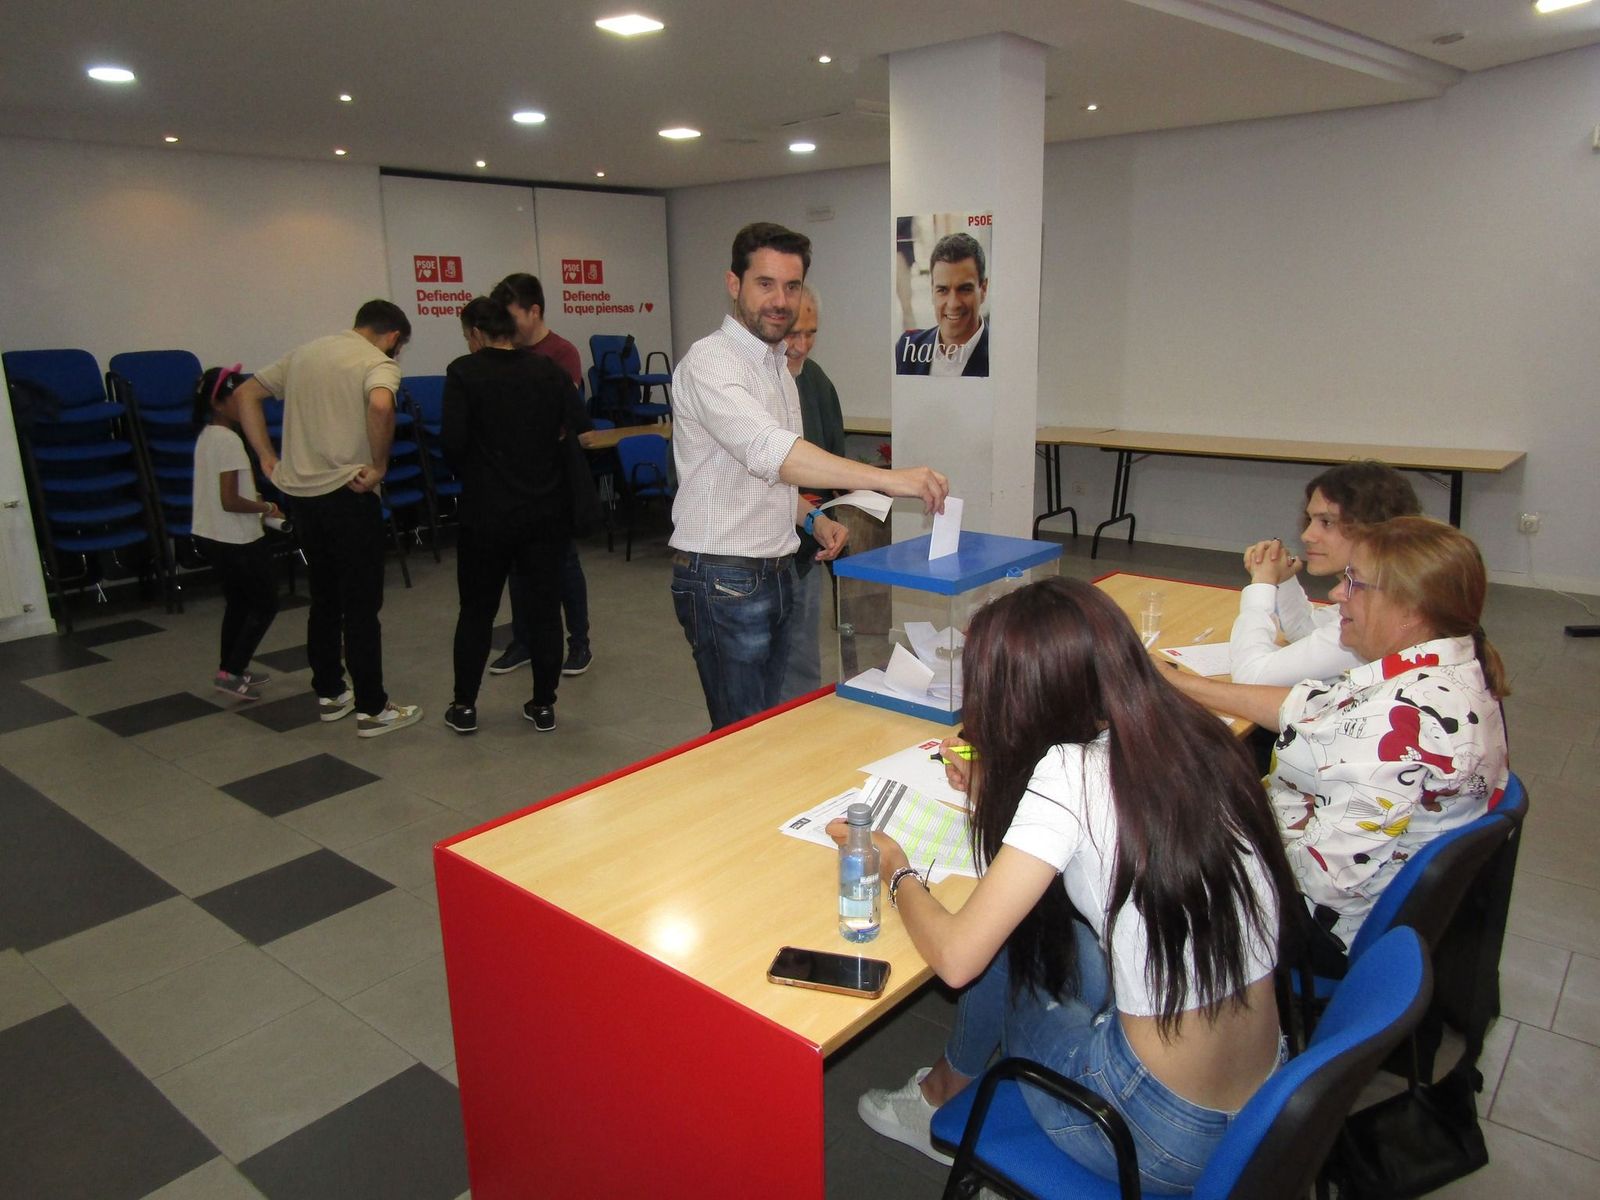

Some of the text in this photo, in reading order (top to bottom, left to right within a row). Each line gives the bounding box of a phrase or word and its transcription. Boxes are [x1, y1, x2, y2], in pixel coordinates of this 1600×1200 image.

[967, 214, 993, 227] PSOE
[416, 260, 437, 270] PSOE
[563, 263, 581, 273] PSOE
[416, 289, 473, 302] Defiende
[562, 290, 611, 302] Defiende
[417, 303, 429, 316] lo
[430, 305, 454, 318] que
[563, 302, 635, 316] lo que piensas
[902, 336, 966, 363] hacer
